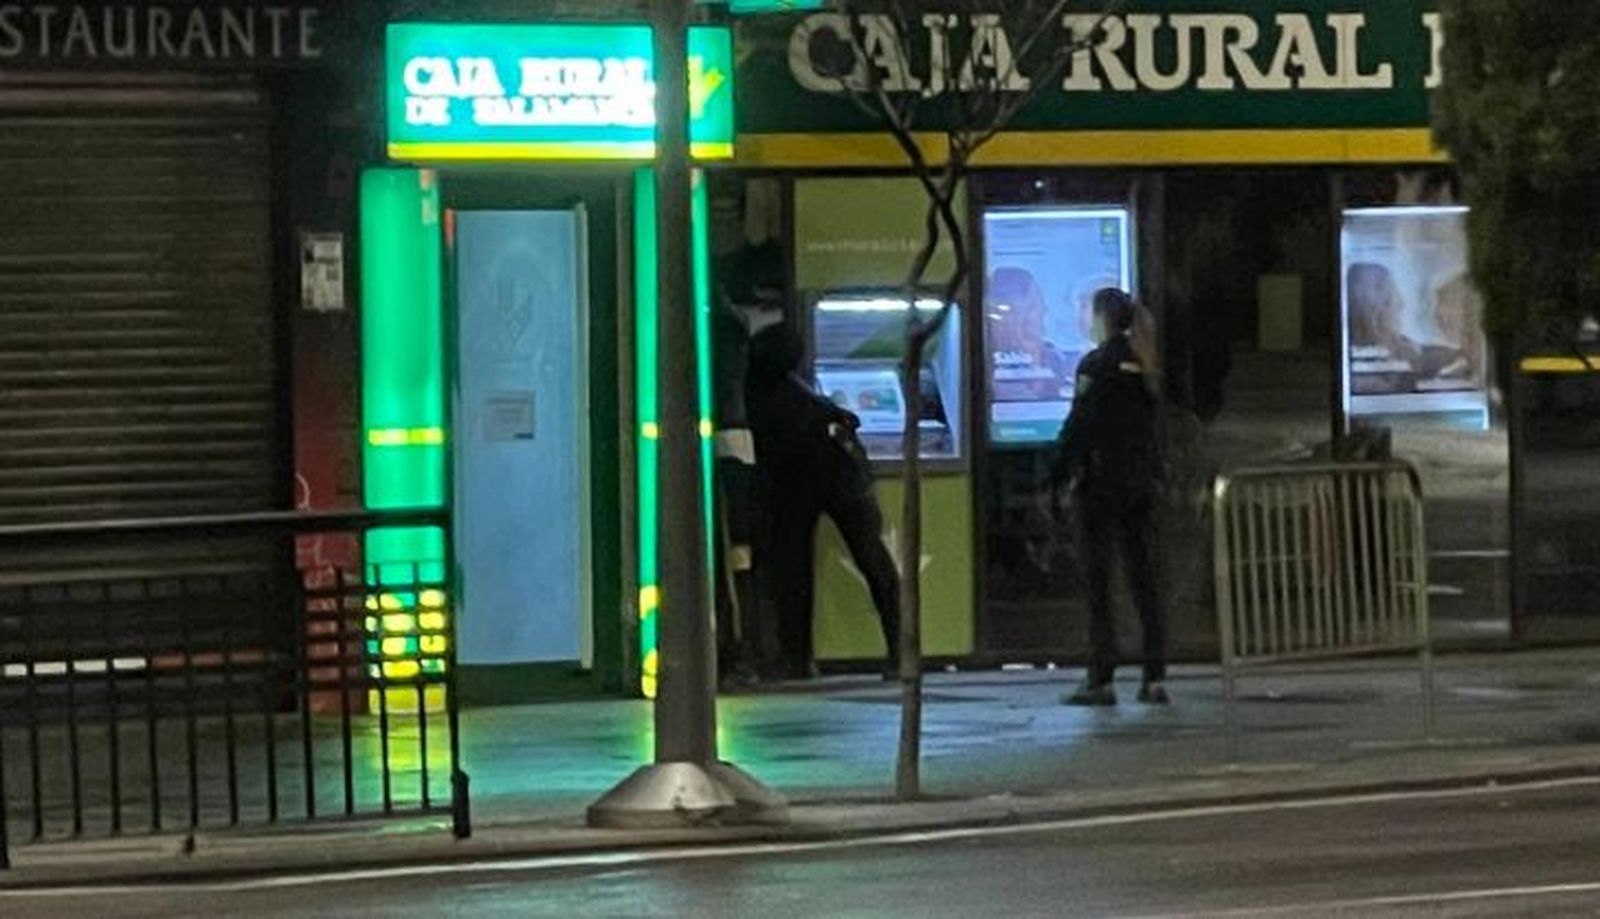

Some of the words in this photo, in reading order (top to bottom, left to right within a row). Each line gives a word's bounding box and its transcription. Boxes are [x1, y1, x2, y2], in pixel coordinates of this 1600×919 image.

[0, 7, 321, 58] STAURANTE
[788, 12, 1031, 98] CAJA
[1062, 12, 1394, 91] RURAL
[404, 57, 504, 96] CAJA
